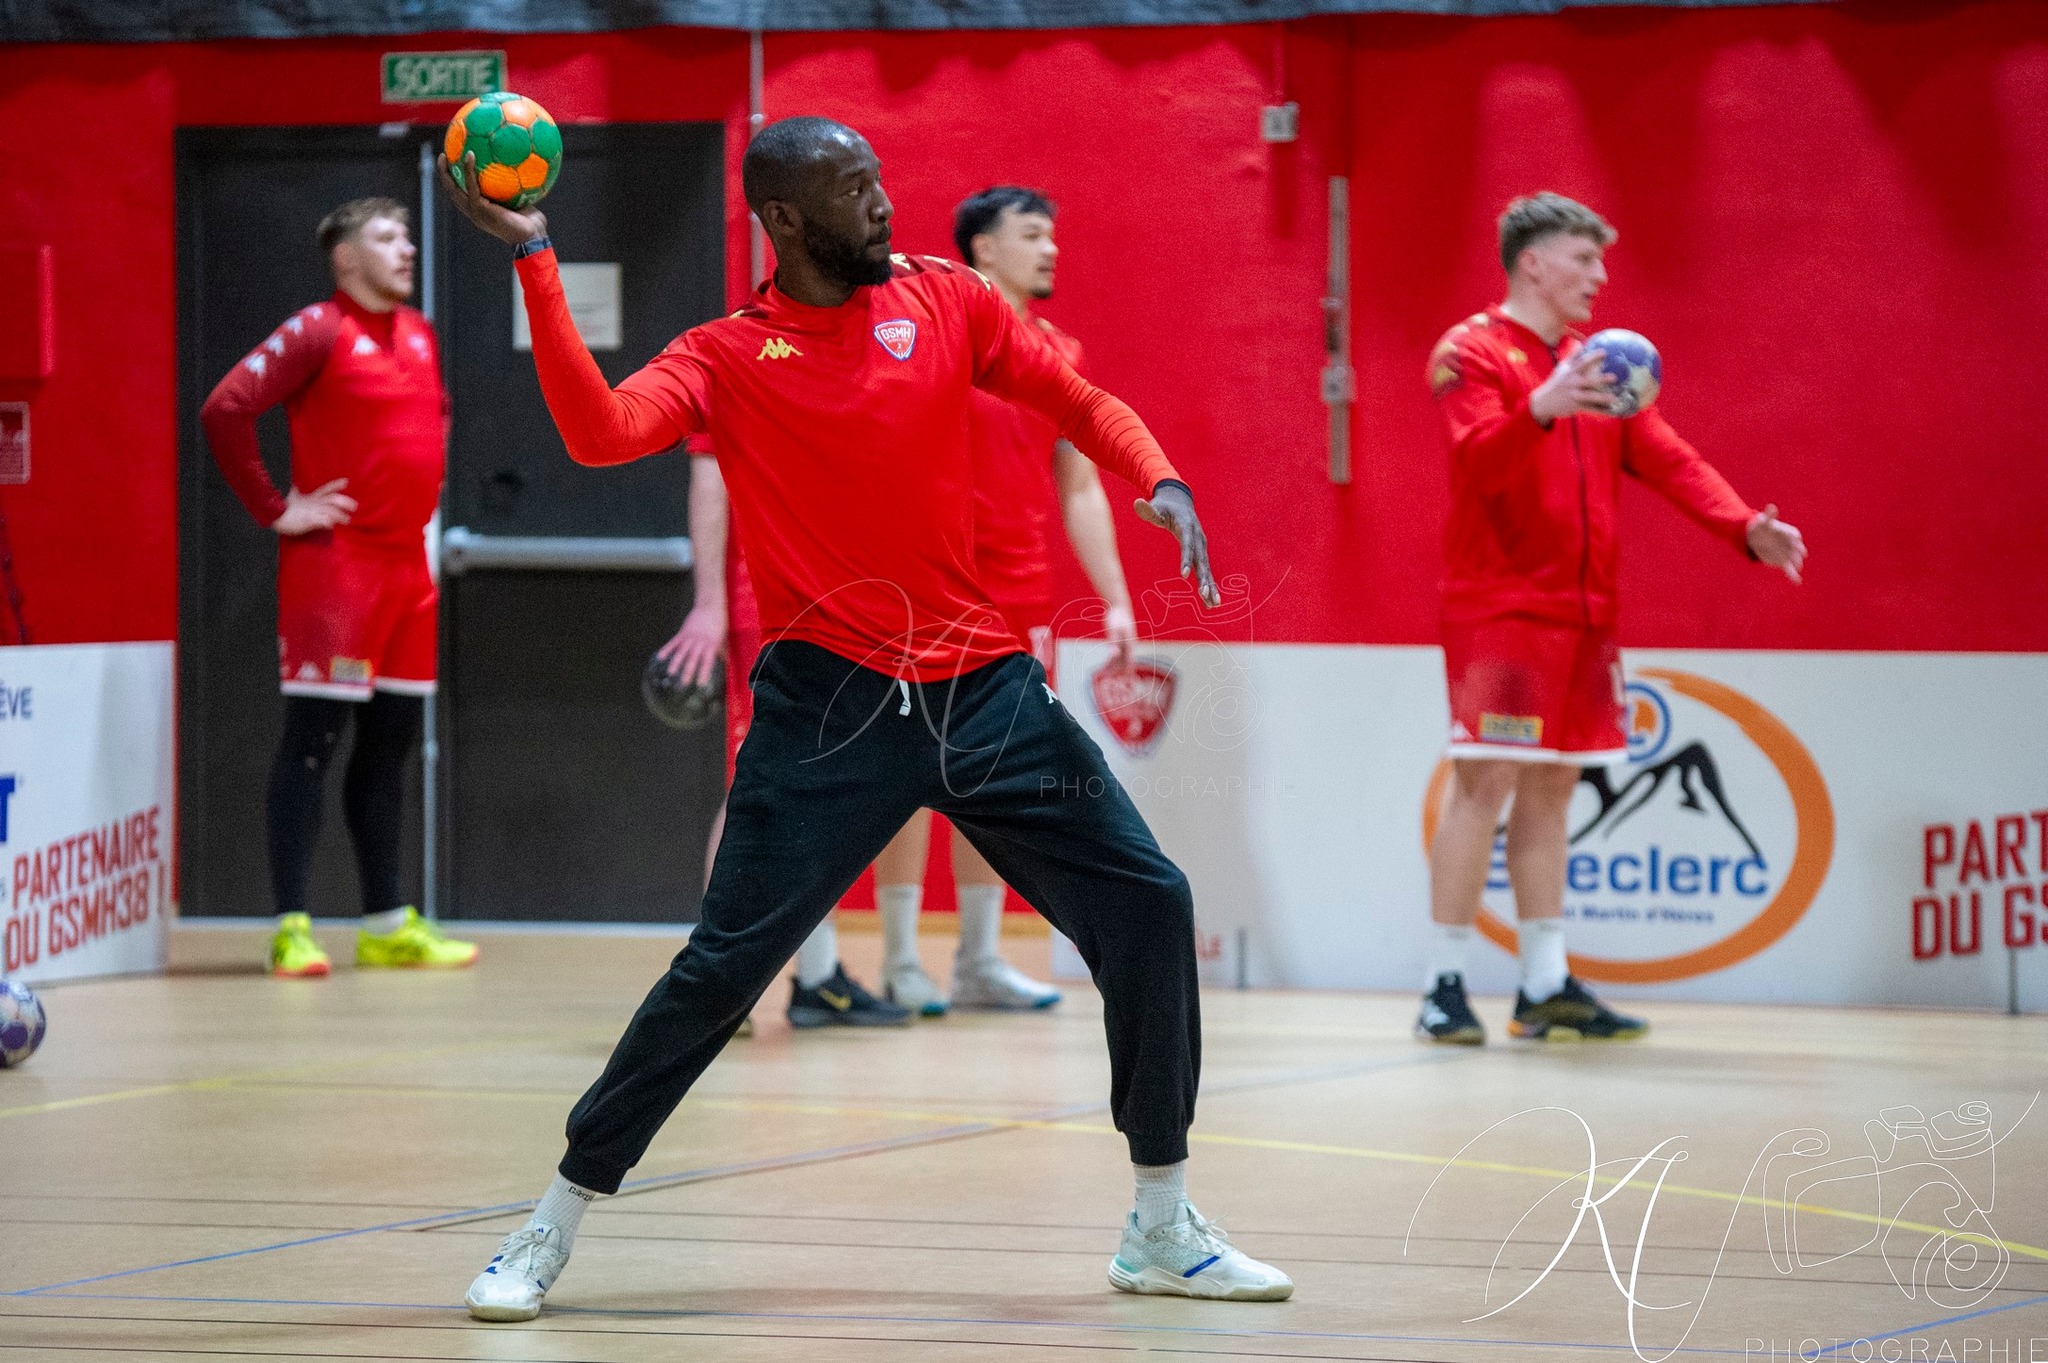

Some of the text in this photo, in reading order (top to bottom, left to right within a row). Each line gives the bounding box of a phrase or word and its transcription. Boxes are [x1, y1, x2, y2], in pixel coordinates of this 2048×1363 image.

[394, 58, 494, 96] SORTIE
[880, 327, 911, 340] GSMH
[12, 804, 160, 911] PARTENAIRE
[5, 909, 39, 973] DU
[49, 868, 149, 956] GSMH38
[1912, 888, 1981, 961] DU
